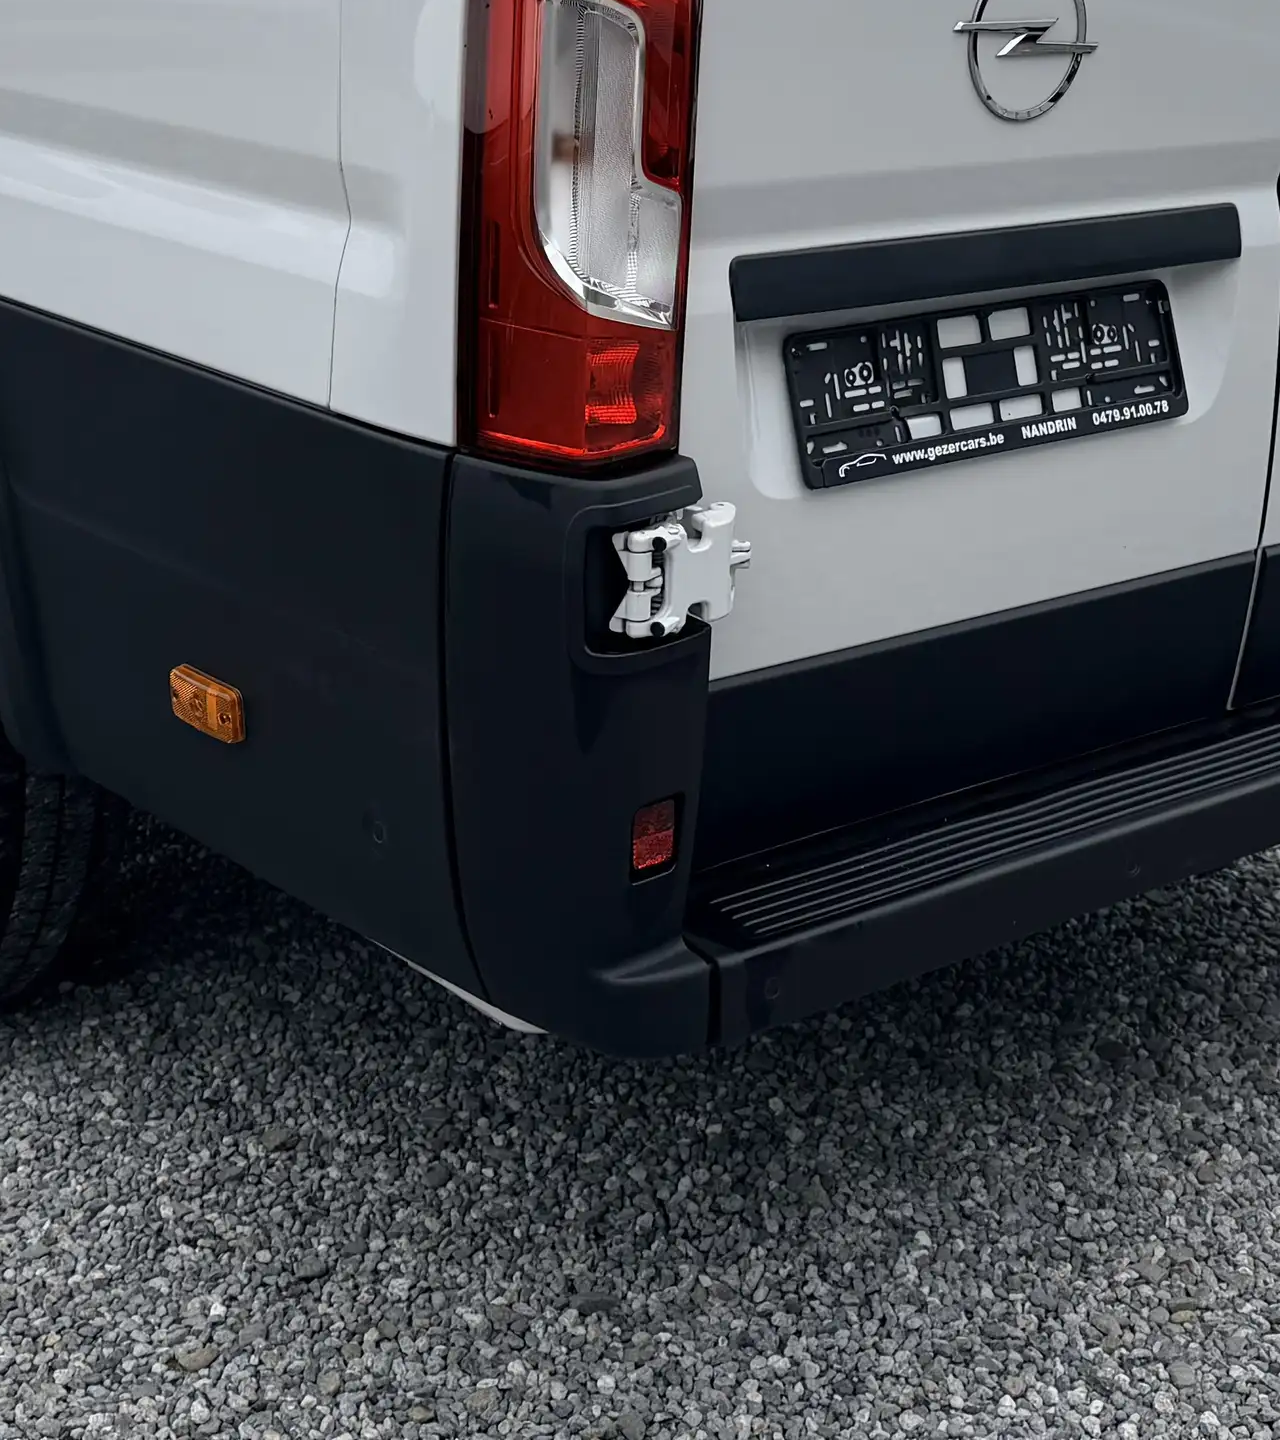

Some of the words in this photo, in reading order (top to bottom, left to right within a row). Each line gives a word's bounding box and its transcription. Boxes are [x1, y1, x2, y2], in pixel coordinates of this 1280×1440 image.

[892, 432, 1005, 465] www.gezercars.be
[1021, 416, 1077, 440] NANDRIN
[1092, 400, 1170, 426] 0479.91.00.78
